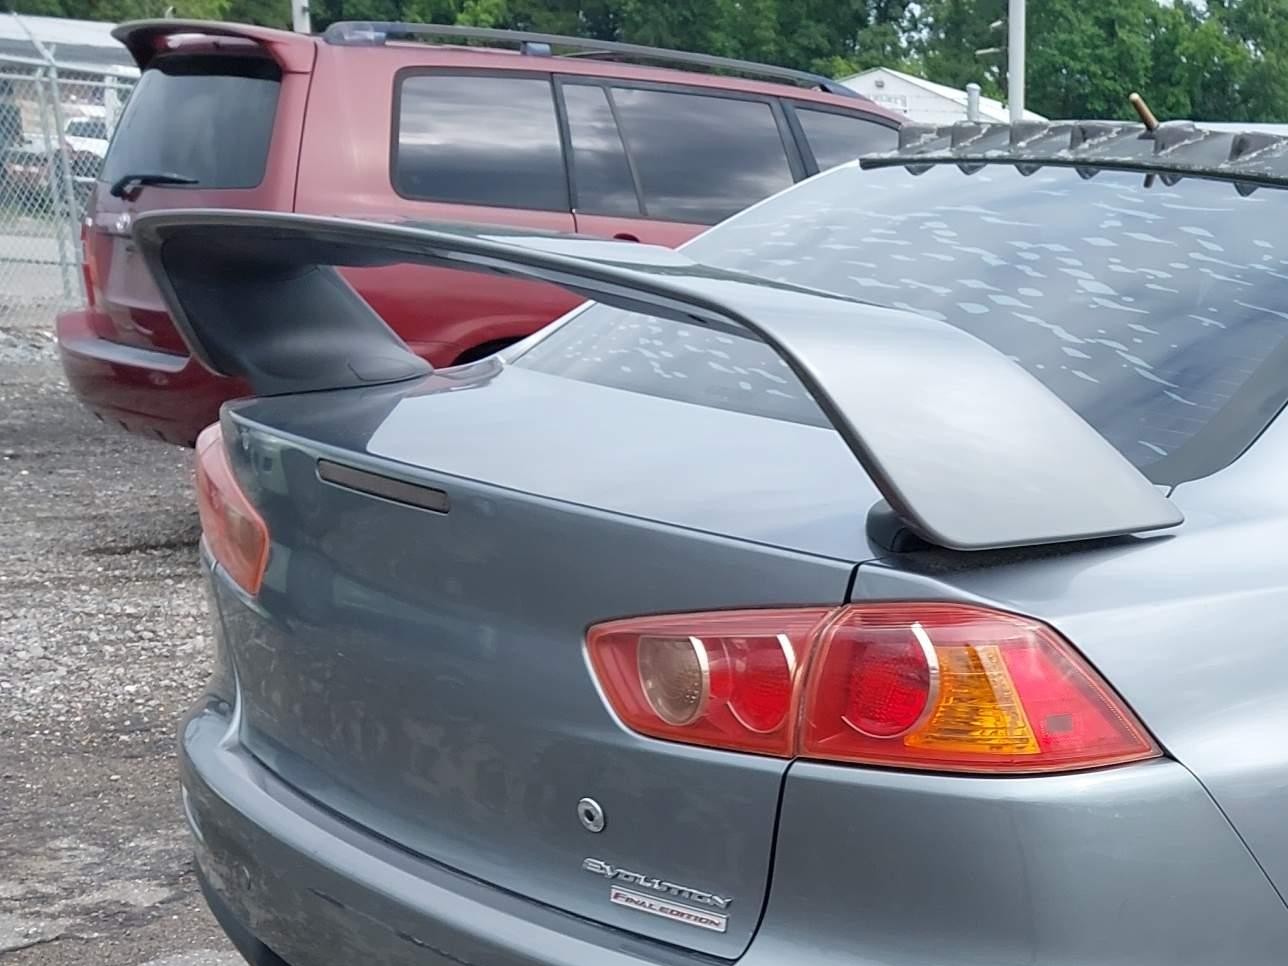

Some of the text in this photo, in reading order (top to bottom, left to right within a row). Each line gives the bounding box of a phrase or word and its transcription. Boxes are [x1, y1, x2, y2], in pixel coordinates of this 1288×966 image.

[582, 857, 733, 909] EVOLUTION
[613, 892, 721, 927] FINAL EDITION
